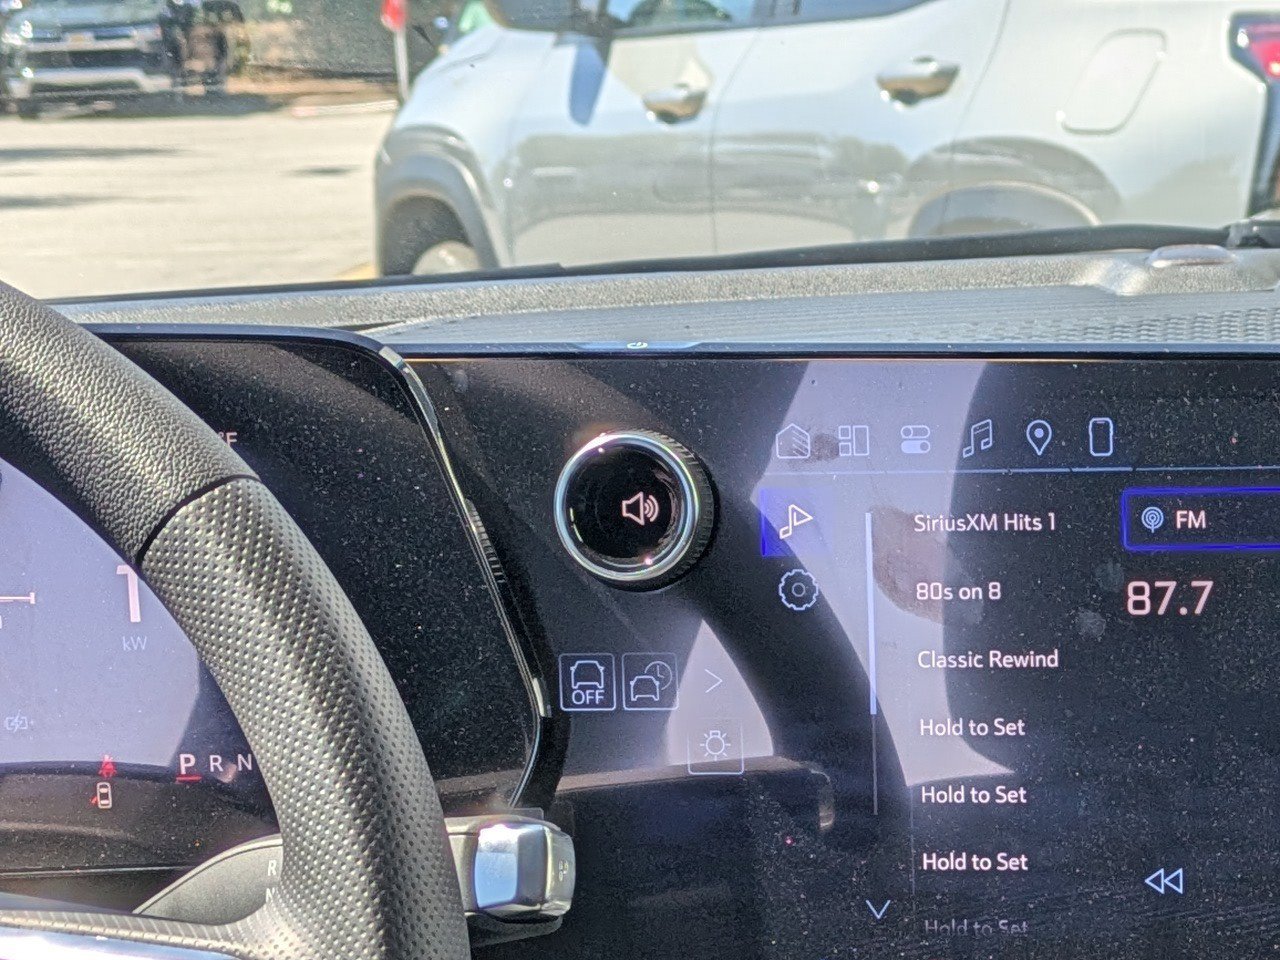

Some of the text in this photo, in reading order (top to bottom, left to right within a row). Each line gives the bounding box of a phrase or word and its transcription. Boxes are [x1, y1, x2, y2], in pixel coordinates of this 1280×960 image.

[914, 512, 1056, 532] SiriusXM Hits 1
[1176, 510, 1207, 529] FM
[916, 582, 1001, 600] 80s on 8
[1127, 580, 1214, 616] 87.7
[122, 636, 147, 651] kW
[917, 649, 1059, 669] Classic Rewind
[571, 690, 605, 705] OFF
[920, 718, 1026, 736] Hold to Set
[179, 753, 254, 775] P R N
[921, 785, 1027, 803] Hold to Set
[923, 852, 1029, 870] Hold to Set
[925, 919, 1029, 936] Hold to Set
